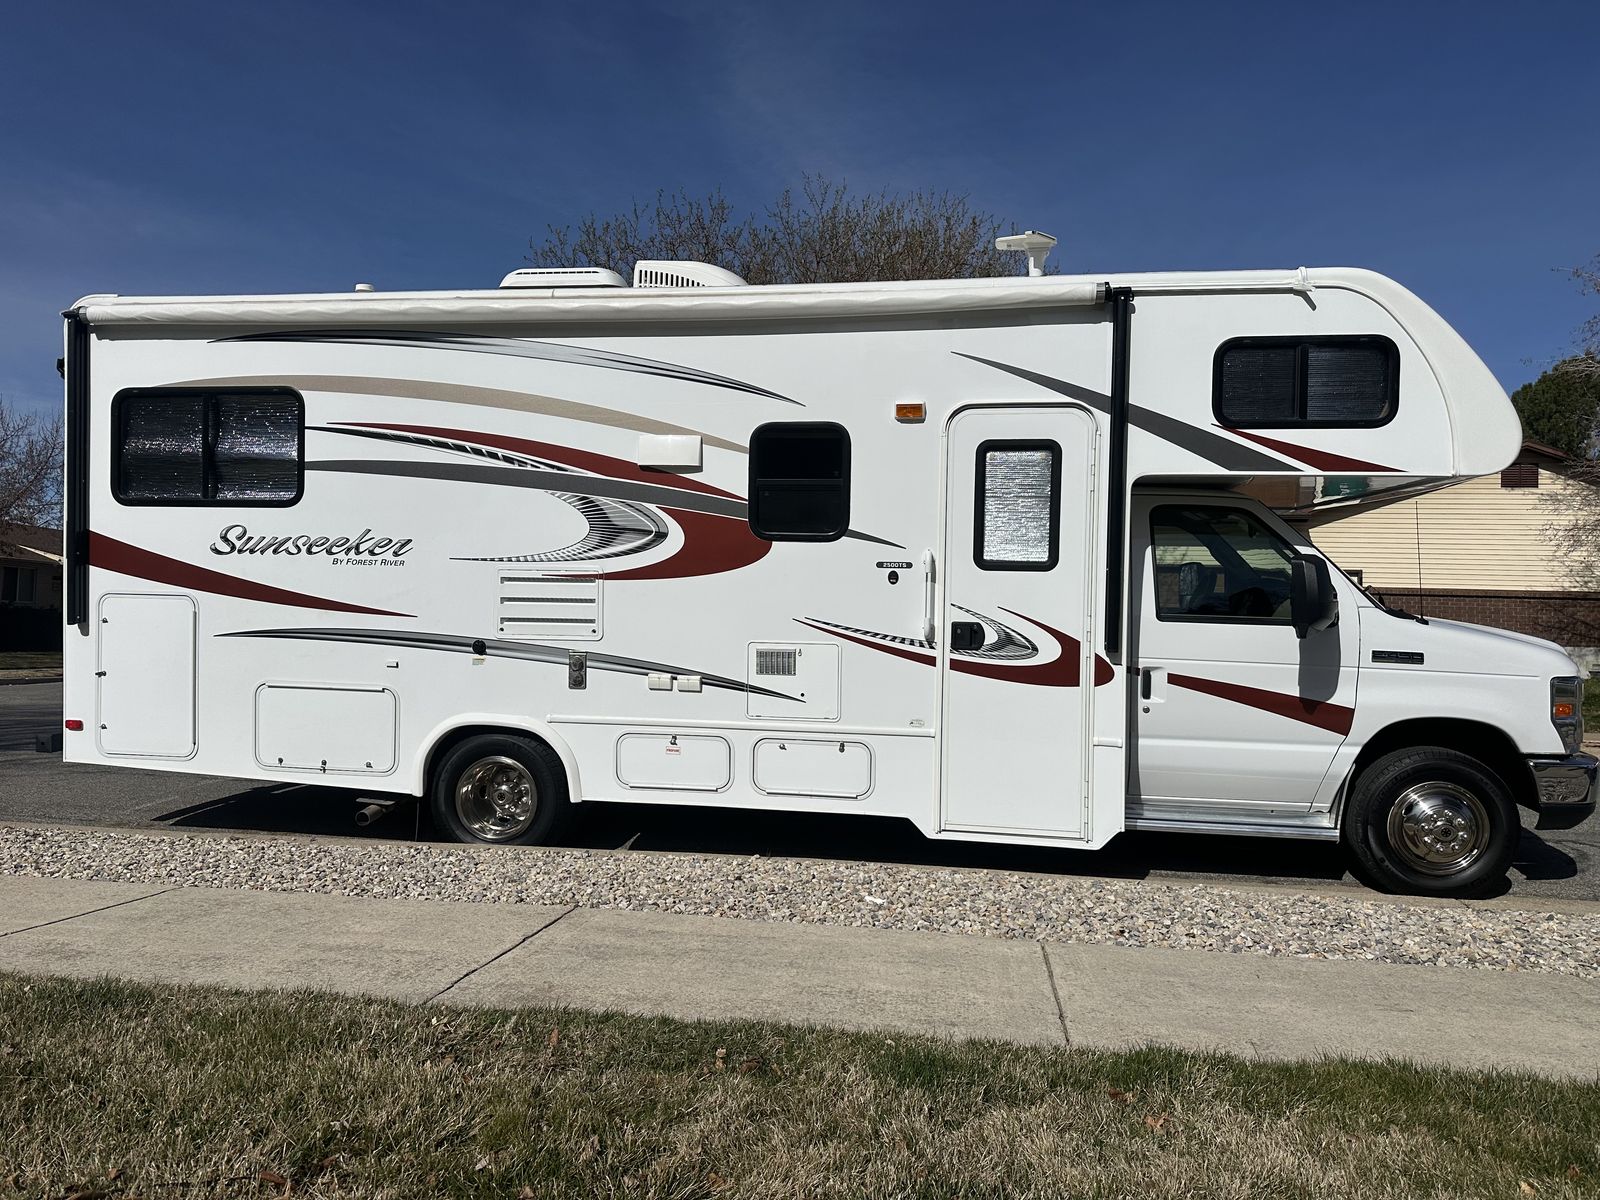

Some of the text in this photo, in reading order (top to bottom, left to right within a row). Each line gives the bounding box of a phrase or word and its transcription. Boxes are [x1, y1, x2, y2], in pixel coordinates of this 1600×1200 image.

[209, 524, 413, 557] Sunseeker
[346, 557, 379, 566] FOREST
[380, 558, 406, 567] RIVER
